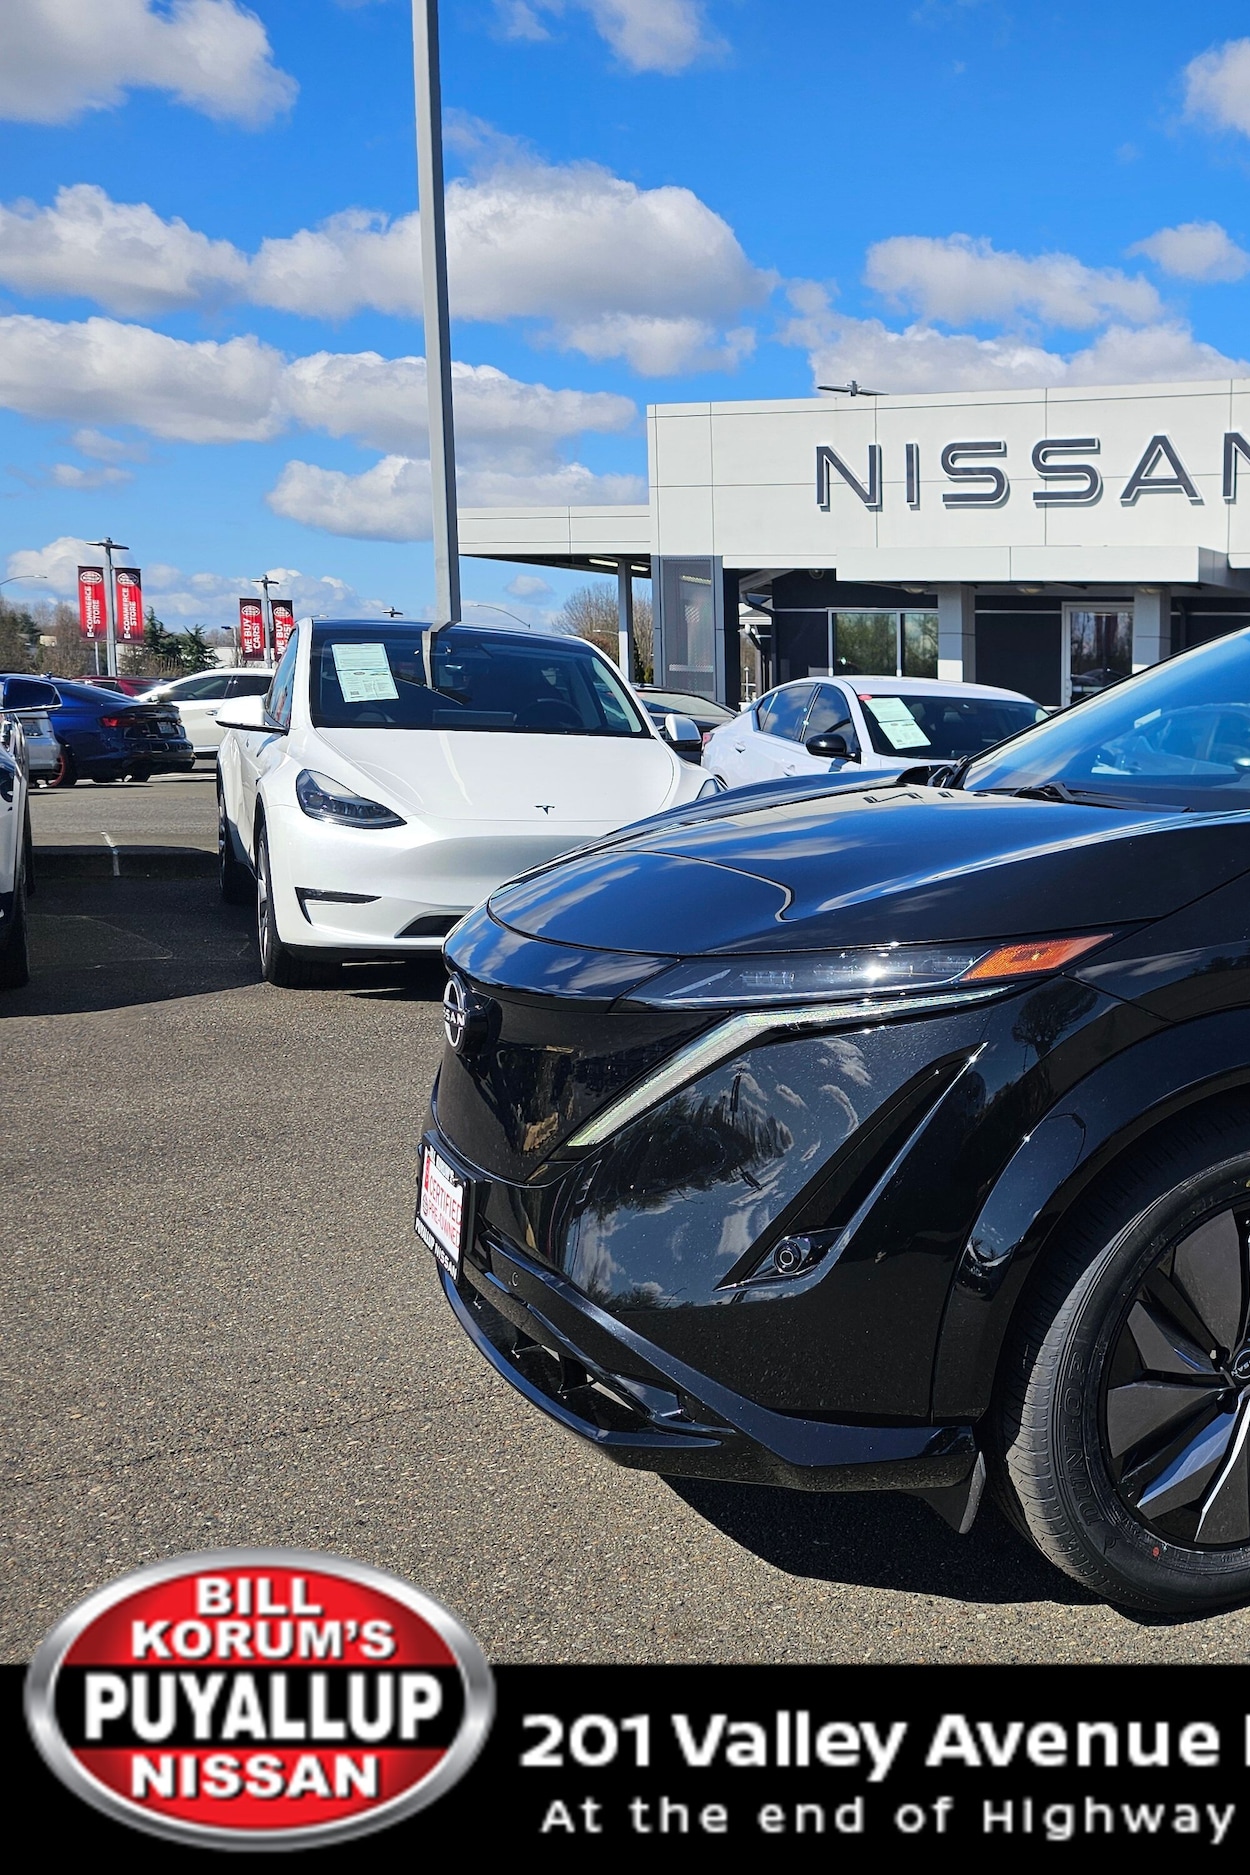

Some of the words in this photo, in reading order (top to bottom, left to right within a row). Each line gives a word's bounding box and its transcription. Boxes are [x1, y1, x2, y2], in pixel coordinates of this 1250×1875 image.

[84, 585, 95, 637] E-COMMERCE
[92, 599, 101, 625] STORE
[121, 587, 131, 639] E-COMMERCE
[129, 601, 137, 627] STORE
[243, 617, 252, 637] BUY
[252, 622, 261, 649] CARS!
[275, 618, 283, 638] BUY
[244, 638, 253, 653] WE
[276, 639, 285, 655] WE
[429, 1175, 463, 1226] CERTIFIED
[428, 1198, 461, 1249] PRE-OWNED
[434, 1244, 458, 1281] NISSAN
[1064, 1351, 1104, 1527] DUNLOP
